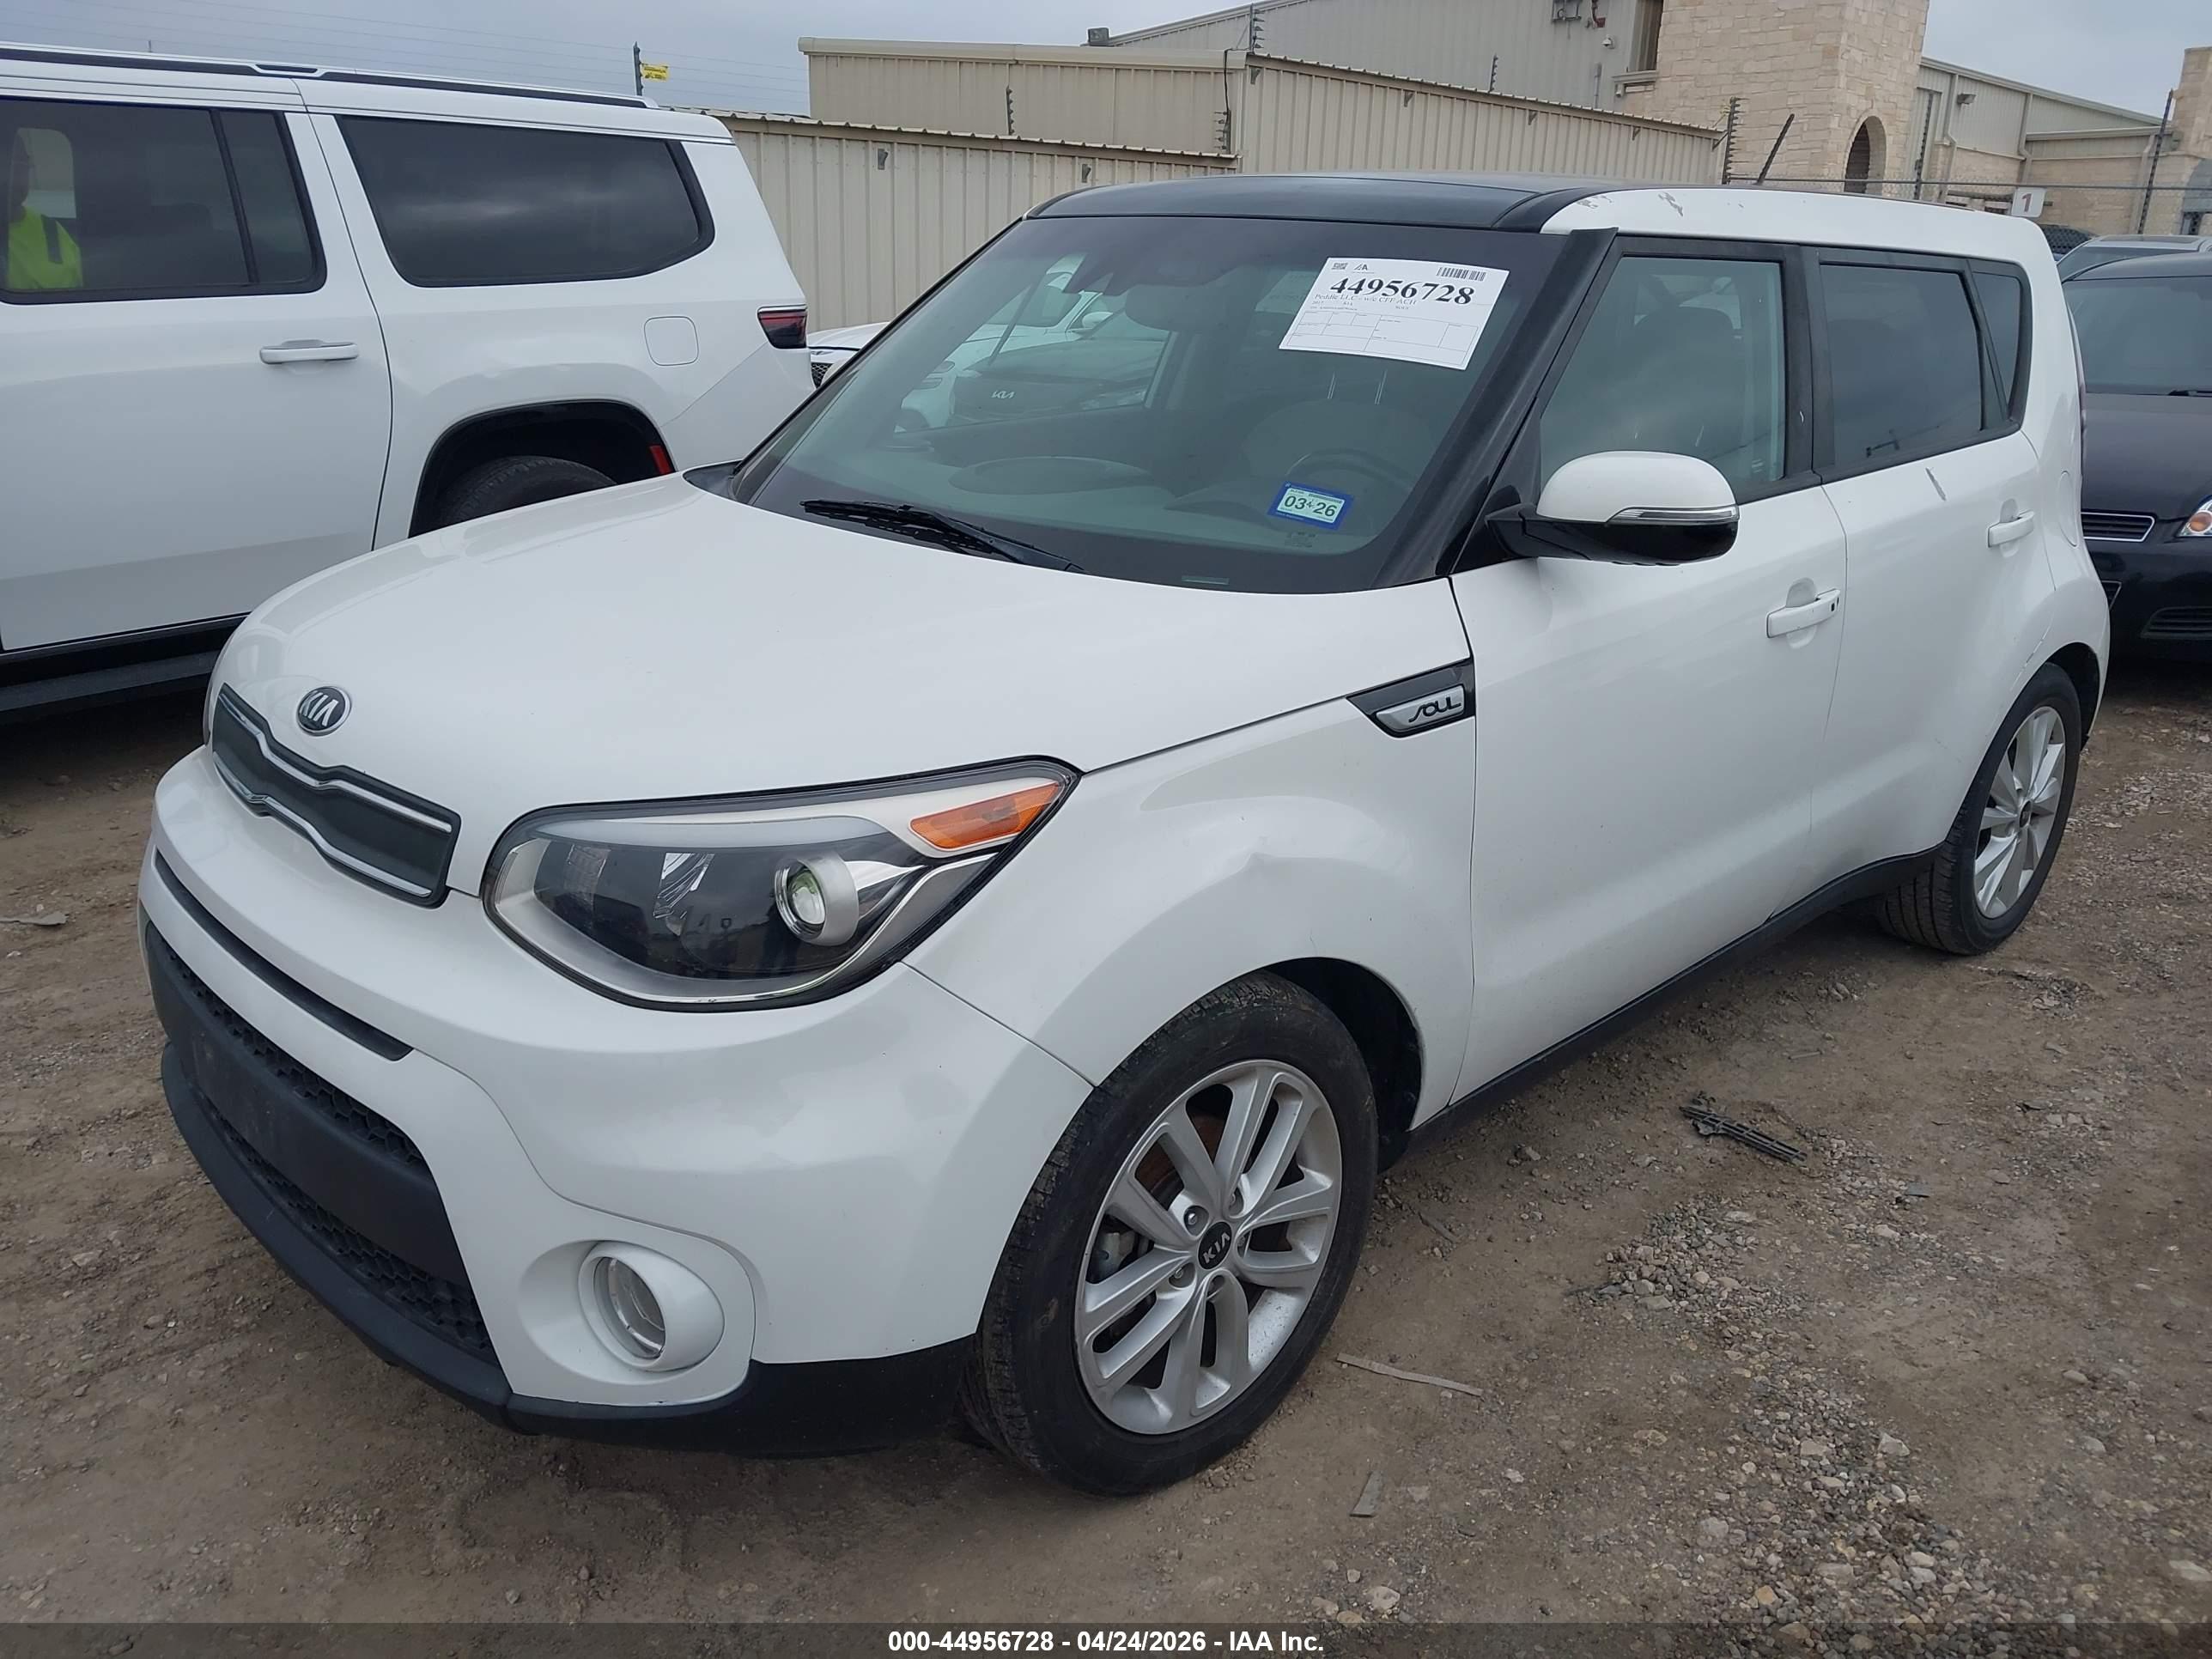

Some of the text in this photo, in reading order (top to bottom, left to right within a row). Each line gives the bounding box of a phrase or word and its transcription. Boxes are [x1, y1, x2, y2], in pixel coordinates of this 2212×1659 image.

[2021, 193, 2032, 212] 1
[1330, 277, 1475, 305] 44956728
[1284, 495, 1307, 510] 03
[1312, 502, 1338, 517] 26
[299, 690, 339, 727] KIA
[1408, 696, 1462, 723] SOUL
[1203, 1232, 1231, 1264] KIA
